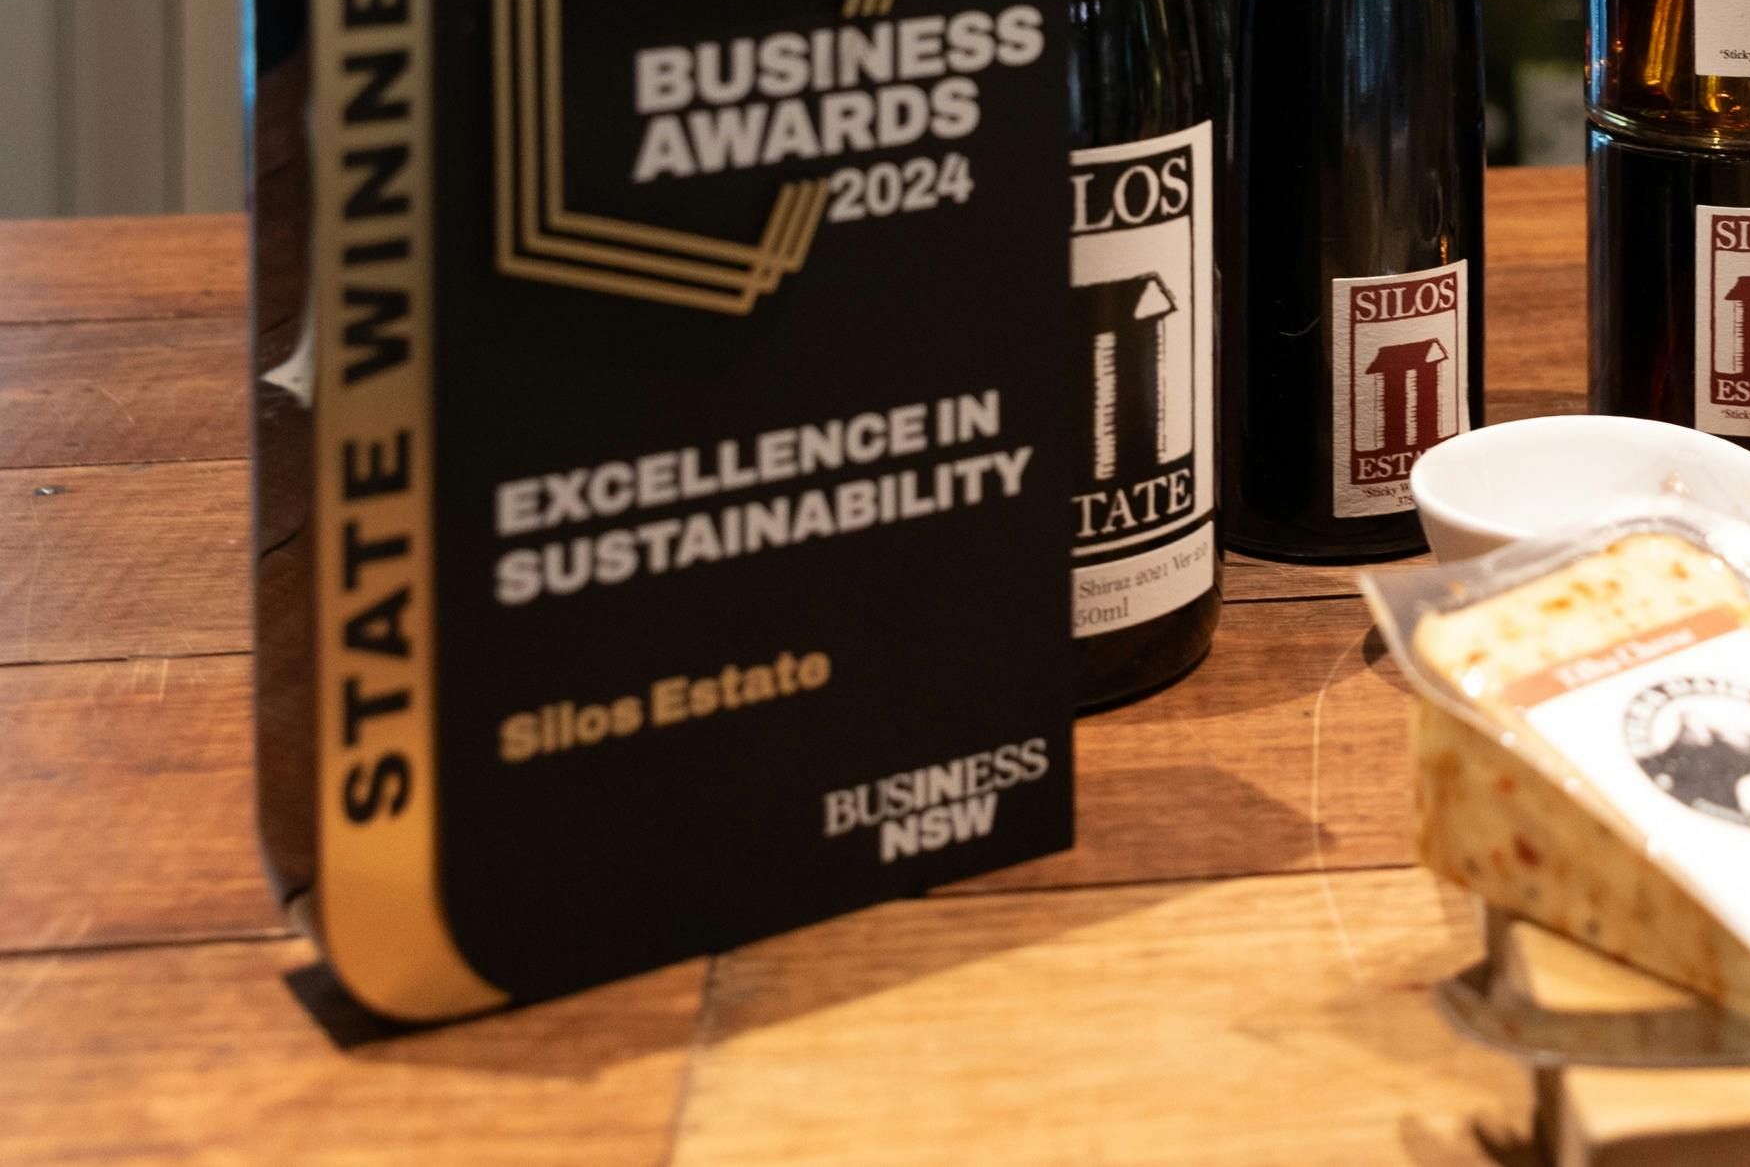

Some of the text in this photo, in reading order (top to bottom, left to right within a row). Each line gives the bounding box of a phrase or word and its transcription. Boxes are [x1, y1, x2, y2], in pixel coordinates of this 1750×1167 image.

[633, 3, 1046, 115] BUSINESS
[631, 76, 982, 184] AWARDS
[827, 152, 975, 223] 2024
[1071, 155, 1189, 233] LOS
[1355, 276, 1456, 322] SILOS
[494, 389, 1001, 535] EXCELLENCE IN
[1071, 467, 1192, 538] TATE
[494, 445, 1035, 606] SUSTAINABILITY
[341, 429, 412, 827] STATE
[1073, 595, 1129, 628] 50ml
[1078, 576, 1132, 599] Shiraz
[499, 651, 832, 763] Silos Estate
[823, 737, 1049, 836] BUSINESS
[879, 792, 998, 863] NSW
